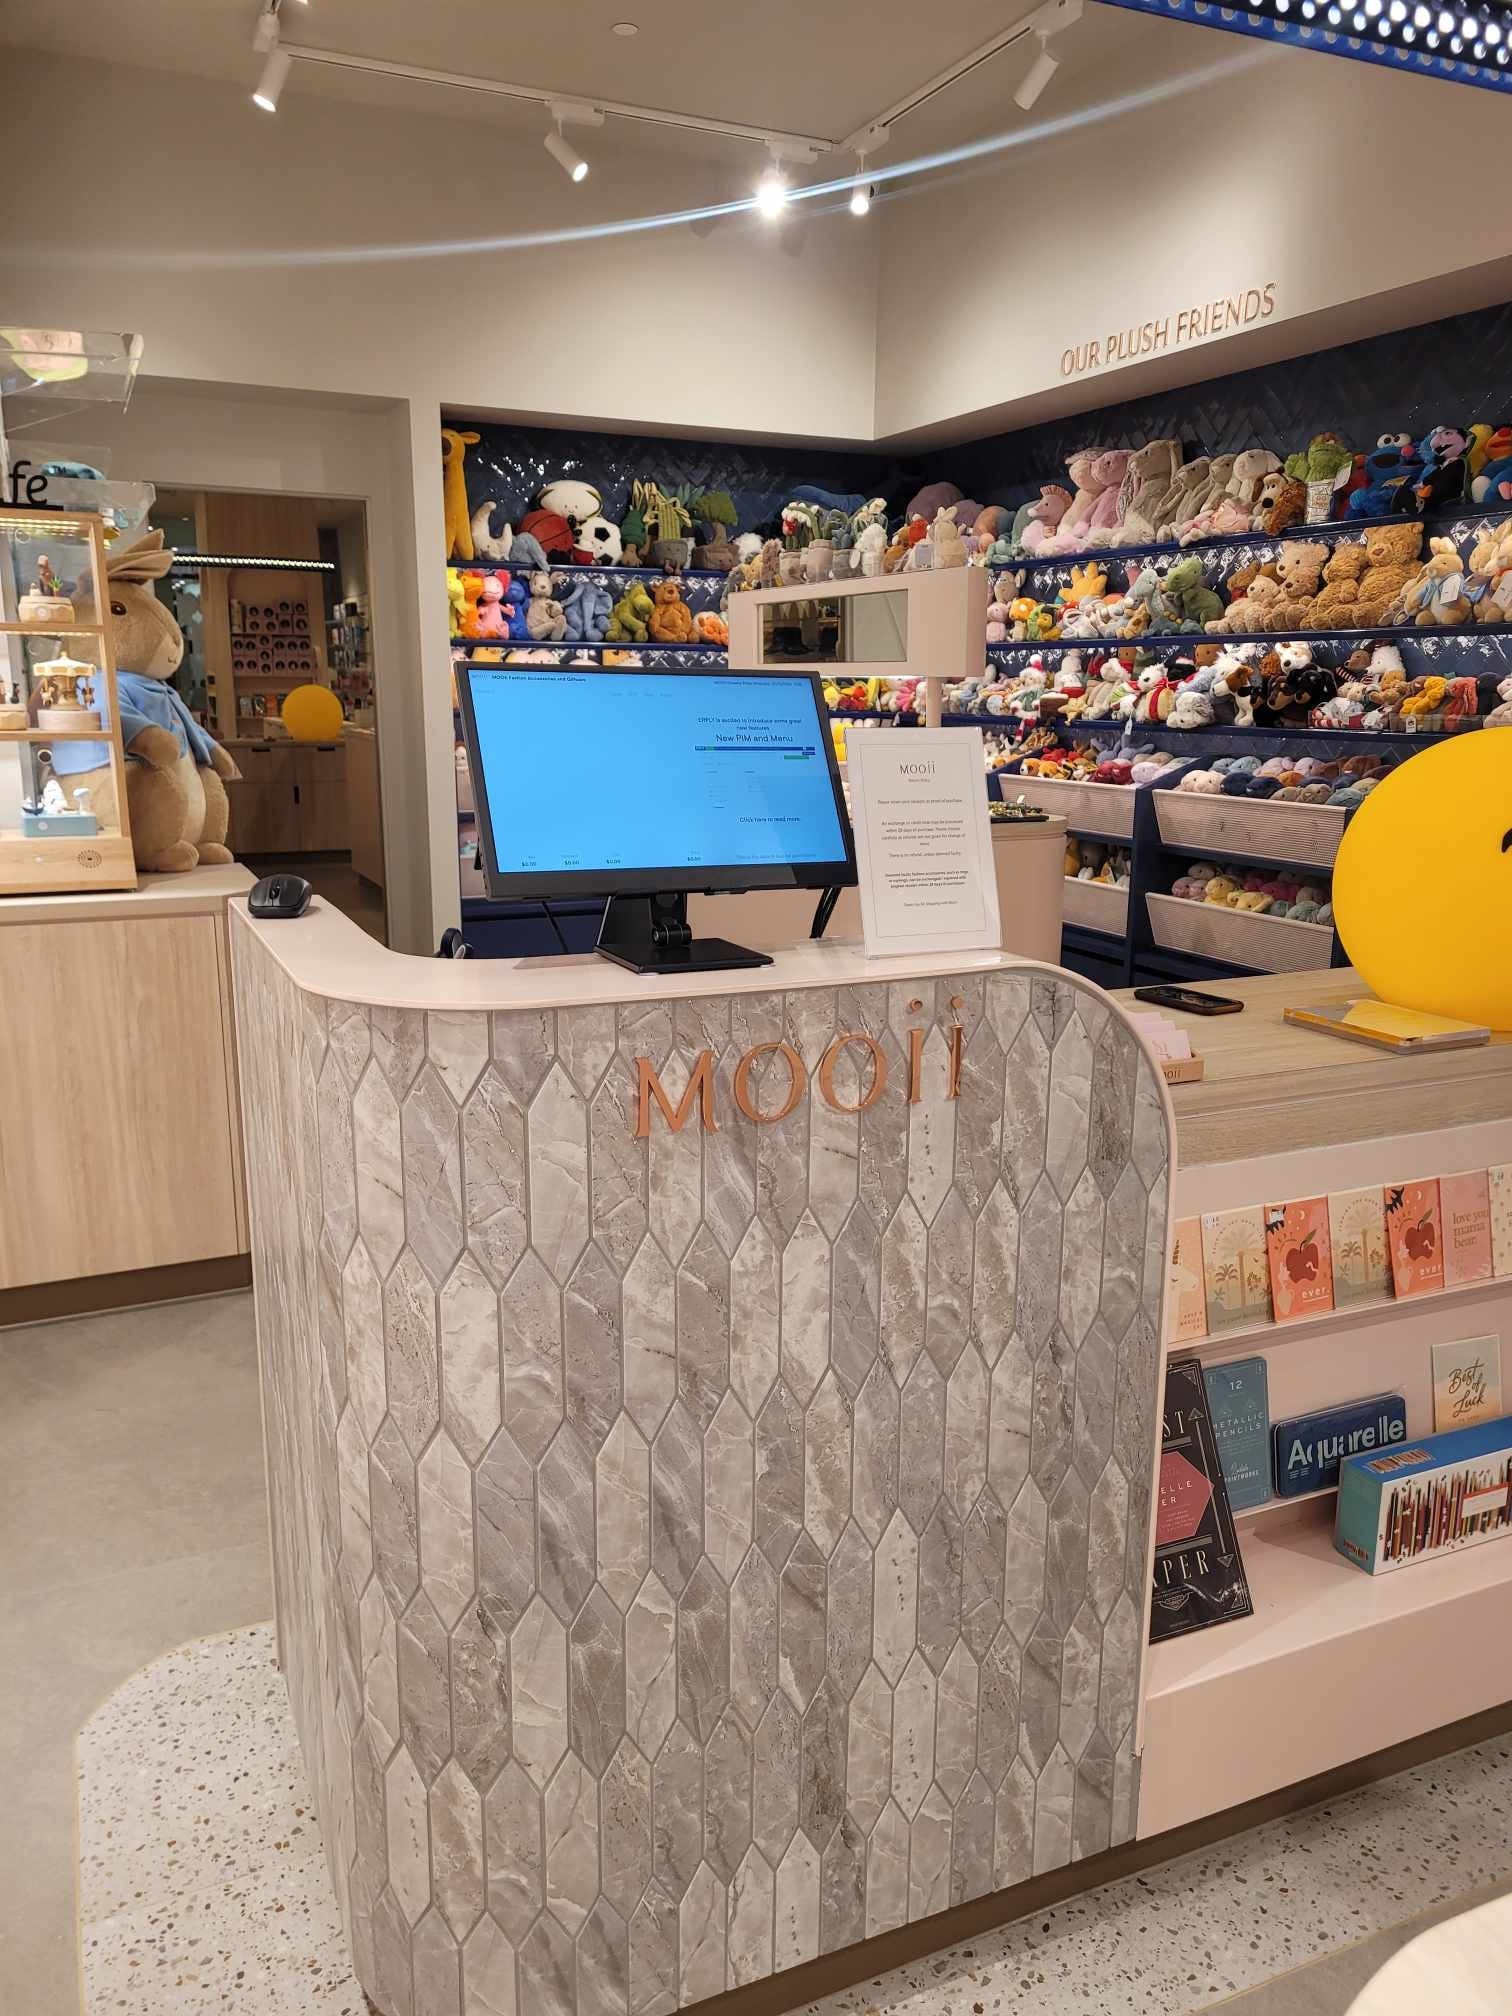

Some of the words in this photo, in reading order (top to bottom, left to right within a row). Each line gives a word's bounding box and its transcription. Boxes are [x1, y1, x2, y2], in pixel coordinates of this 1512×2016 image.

[1060, 341, 1101, 377] OUR
[1105, 317, 1170, 364] PLUSH
[1175, 282, 1277, 345] FRIENDS
[716, 734, 734, 743] New
[736, 734, 752, 742] PIM
[753, 734, 768, 742] and
[770, 735, 793, 743] Menu
[1453, 1212, 1472, 1225] love
[1473, 1208, 1488, 1220] you
[1454, 1222, 1486, 1237] mama
[1448, 1357, 1485, 1394] Best
[1471, 1373, 1484, 1393] of
[1230, 1380, 1243, 1391] 12
[1452, 1382, 1487, 1418] Luck
[1215, 1423, 1261, 1440] PENCILS
